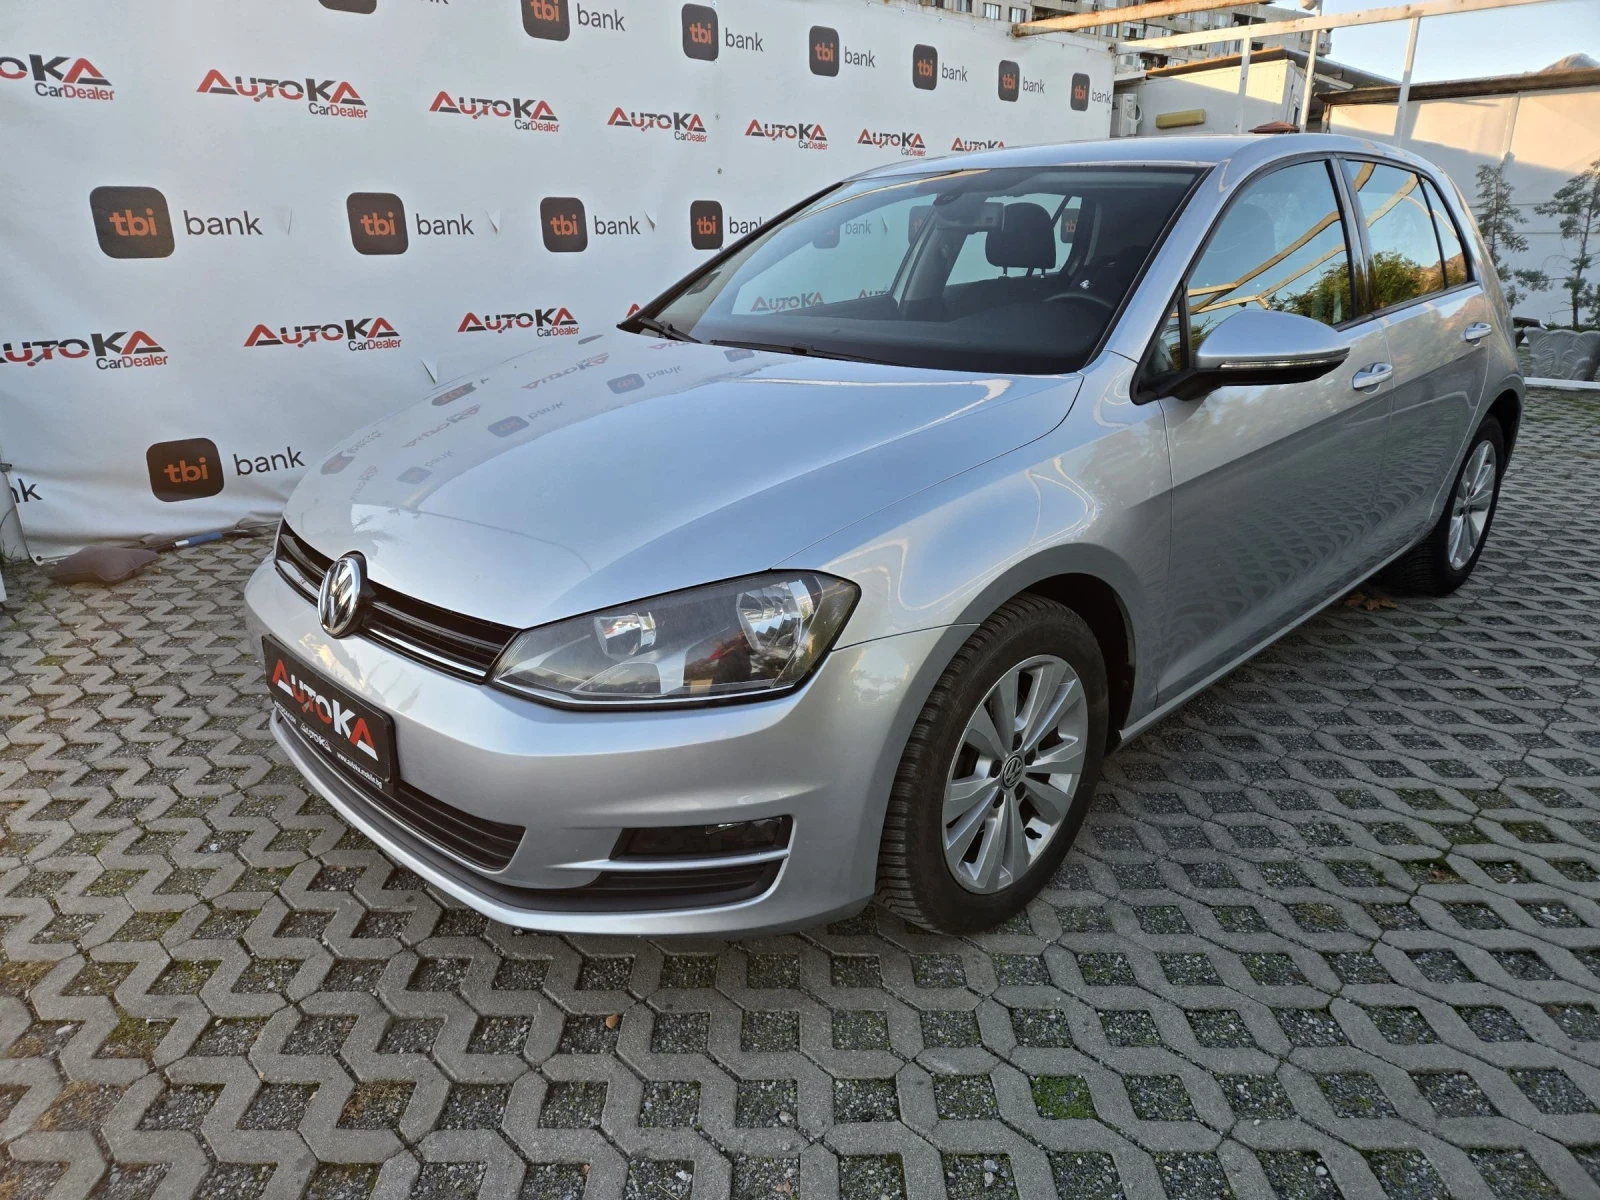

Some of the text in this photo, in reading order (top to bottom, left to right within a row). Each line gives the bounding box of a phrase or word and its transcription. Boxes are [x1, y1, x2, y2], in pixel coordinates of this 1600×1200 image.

[530, 0, 626, 31] tbi bank
[689, 23, 764, 52] tbi bank
[815, 42, 875, 68] tbi bank
[0, 54, 112, 86] OKA
[917, 59, 968, 82] tbi bank
[34, 82, 115, 101] CarDealer
[196, 69, 366, 106] AUTOKA
[1002, 74, 1045, 94] tbi bank
[1075, 85, 1112, 104] tbi bank
[308, 102, 368, 118] CarDealer
[429, 91, 559, 122] AUTOKA
[514, 118, 560, 133] CarDealer
[607, 107, 706, 132] AUTOKA
[744, 119, 828, 141] AUTOKA
[674, 130, 708, 143] CarDealer
[798, 139, 829, 150] CarDealer
[857, 128, 926, 148] AUTOKA
[109, 208, 263, 236] tbi bank
[360, 211, 474, 236] tbi bank
[550, 214, 640, 236] tbi bank
[697, 215, 716, 235] tbi
[845, 219, 871, 236] bank
[458, 307, 579, 334] AUTOKA
[537, 325, 580, 338] CarDealer
[243, 316, 400, 348] AUTOKA
[0, 330, 166, 367] UTOKA
[348, 336, 402, 352] CarDealer
[96, 355, 168, 370] CarDealer
[163, 457, 209, 484] tbi
[233, 446, 305, 476] bank
[272, 659, 379, 762] AUTOKA
